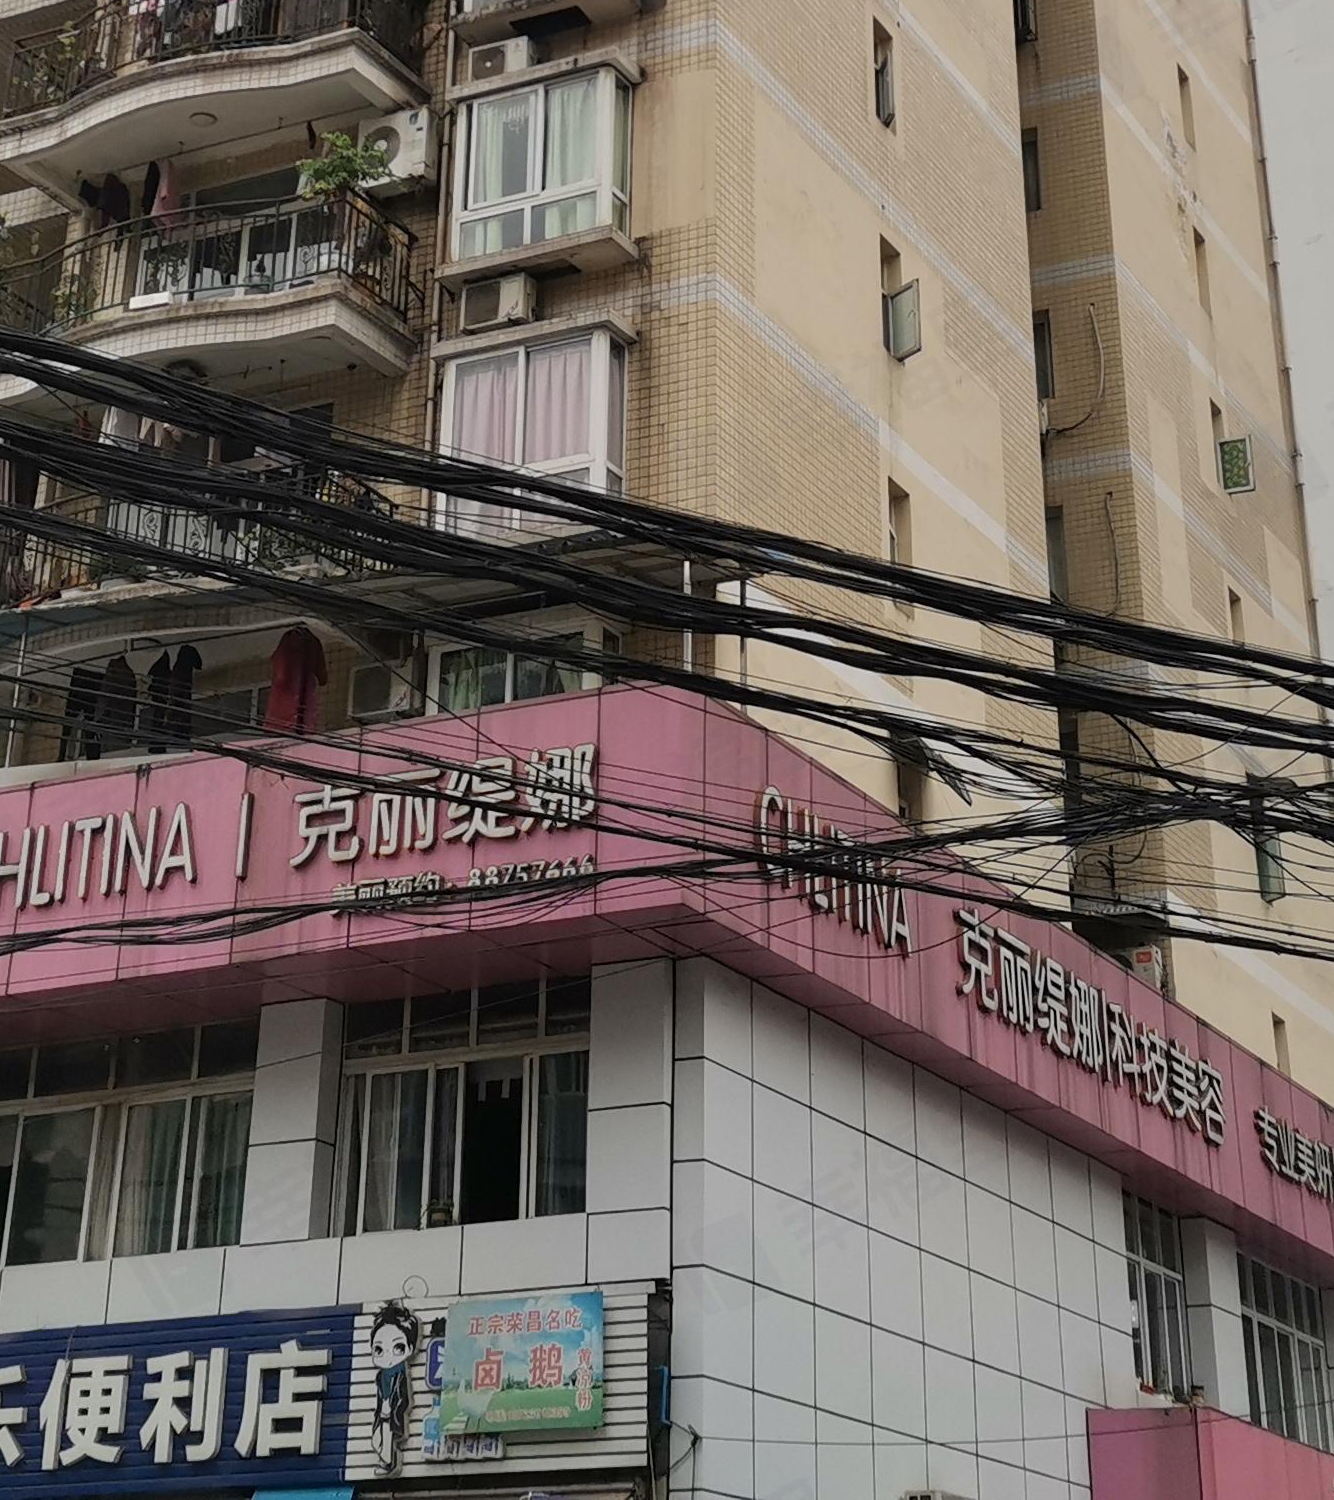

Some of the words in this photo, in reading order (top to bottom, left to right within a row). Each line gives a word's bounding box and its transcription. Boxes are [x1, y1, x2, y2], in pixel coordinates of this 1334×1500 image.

[291, 743, 597, 869] 克丽缇娜
[468, 1307, 584, 1336] 正宗荣昌名吃
